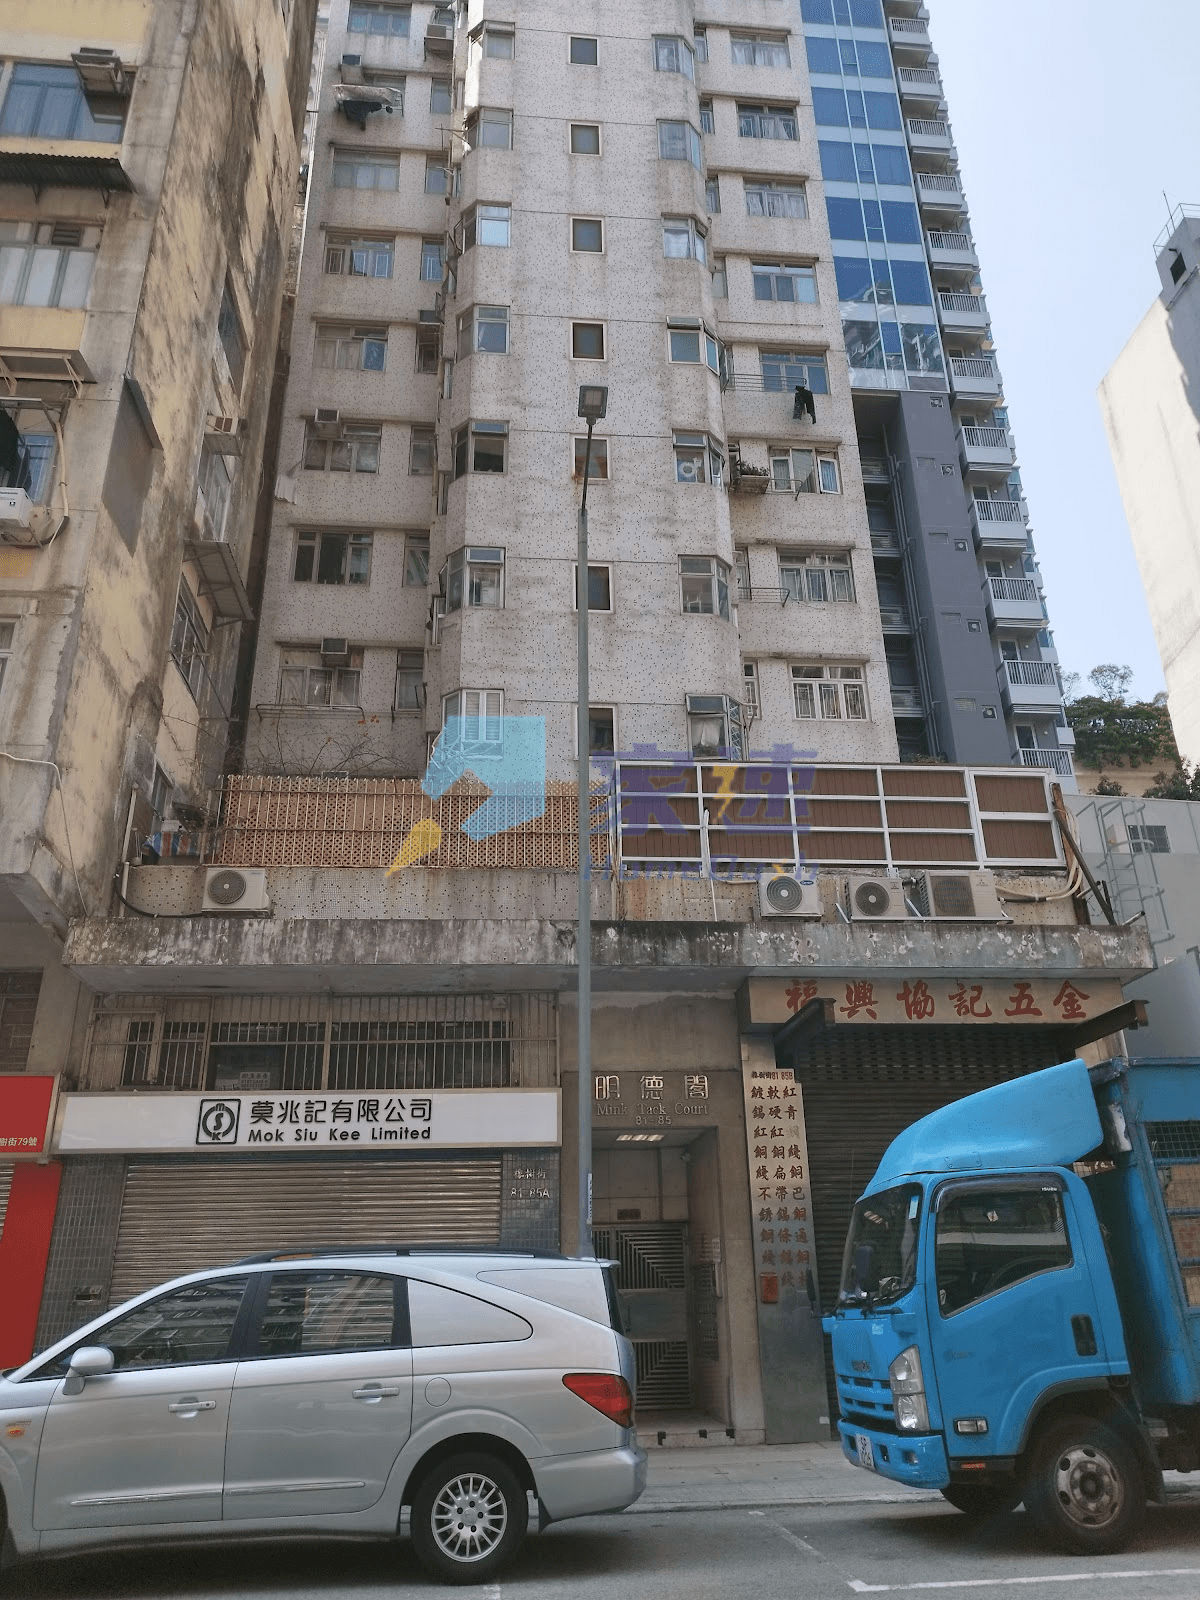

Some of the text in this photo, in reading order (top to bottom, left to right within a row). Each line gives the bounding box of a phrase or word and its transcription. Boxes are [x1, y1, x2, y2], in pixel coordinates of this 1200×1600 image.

[595, 1075, 709, 1100] 明德閣
[249, 1098, 433, 1124] 莫兆記有限公司
[596, 1102, 709, 1115] Mink Tack Court
[248, 1126, 431, 1142] Mok Siu Kee Limited
